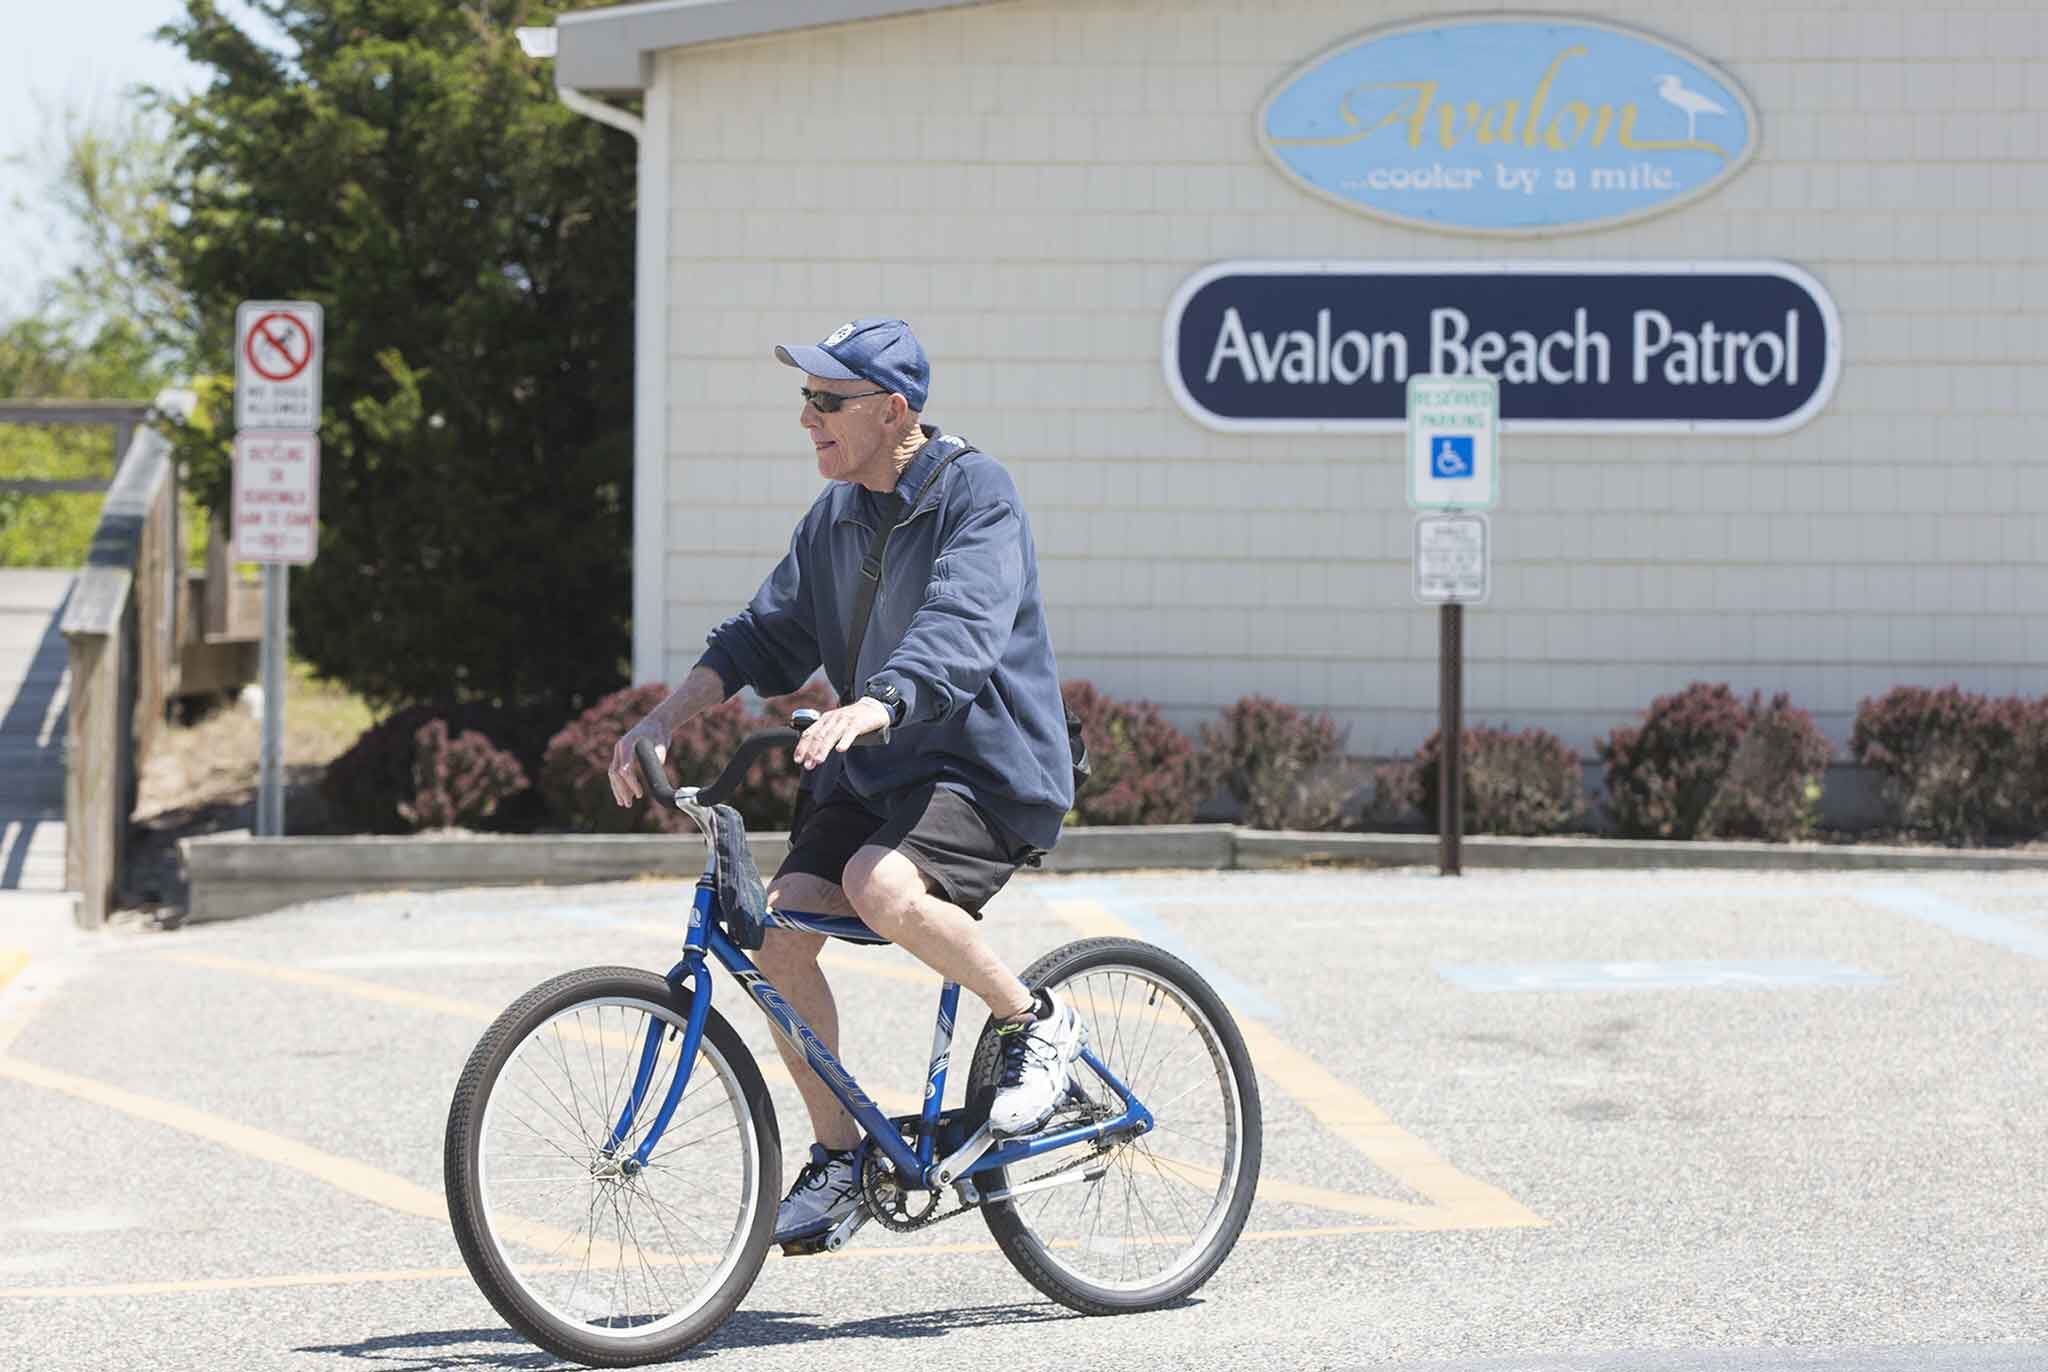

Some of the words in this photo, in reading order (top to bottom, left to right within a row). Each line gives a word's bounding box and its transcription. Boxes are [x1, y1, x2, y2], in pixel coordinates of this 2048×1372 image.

[1339, 44, 1642, 151] Avalon
[1495, 161, 1541, 195] by
[1554, 167, 1577, 190] a
[1205, 306, 1408, 384] Avalon
[1429, 306, 1611, 385] Beach
[1632, 308, 1799, 386] Patrol
